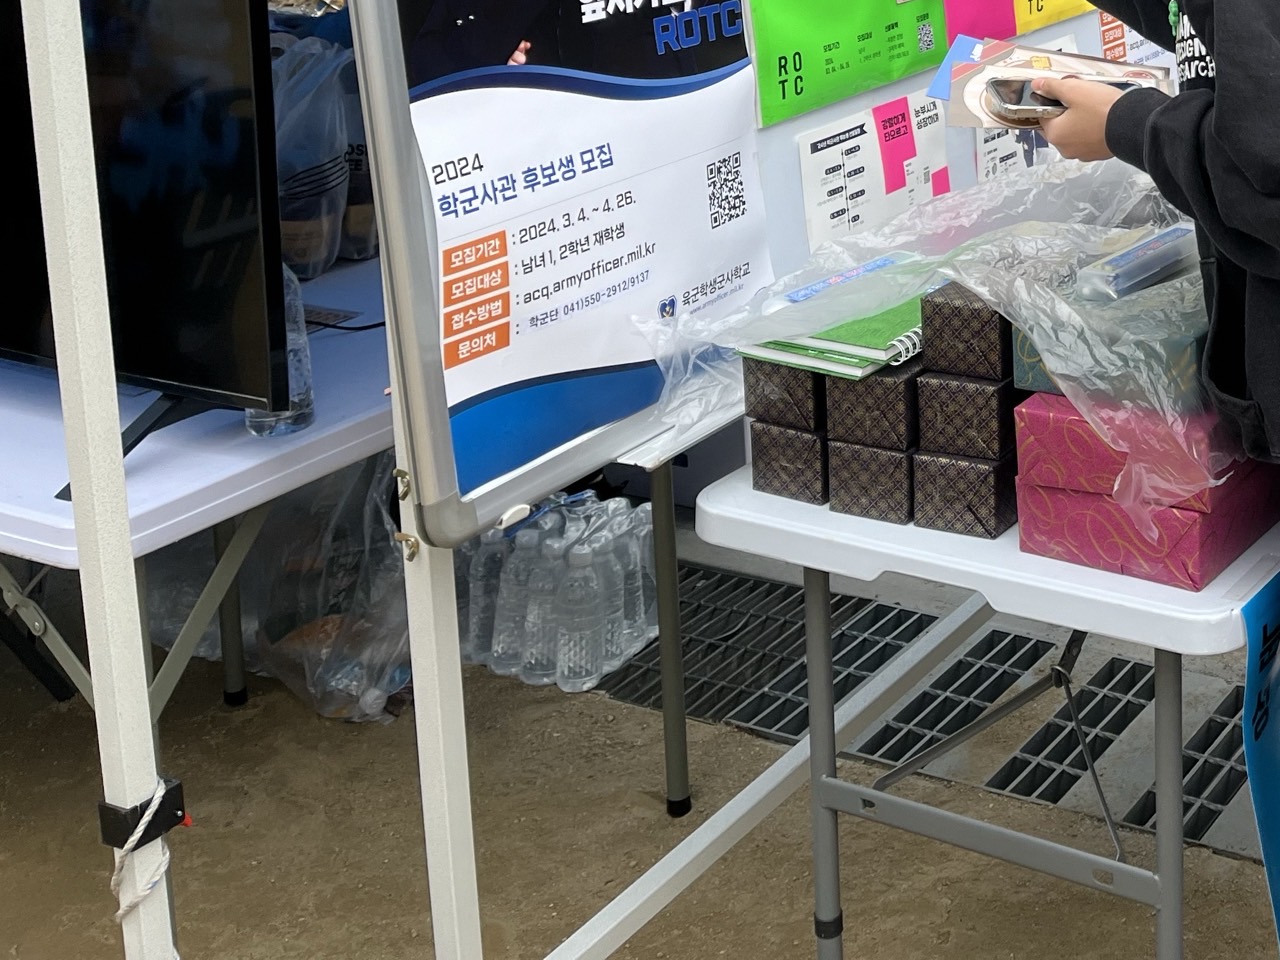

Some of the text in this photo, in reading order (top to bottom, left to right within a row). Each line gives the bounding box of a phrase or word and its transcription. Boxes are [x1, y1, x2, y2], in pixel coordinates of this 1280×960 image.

[431, 153, 484, 185] 2024
[437, 142, 614, 218] 학군사관 후보생 모집
[450, 238, 501, 269] 모집기간
[451, 269, 503, 300] 모집대상
[521, 254, 546, 275] 남녀
[559, 235, 591, 260] 2학년
[592, 222, 626, 246] 재학생
[451, 300, 503, 331] 접수방법
[523, 242, 657, 304] acq.armyofficer.mil.kr
[682, 261, 751, 307] 육군학생군사학교
[457, 332, 497, 359] 문의처
[529, 307, 560, 328] 학군단
[563, 270, 650, 316] 041)550-2912/9137
